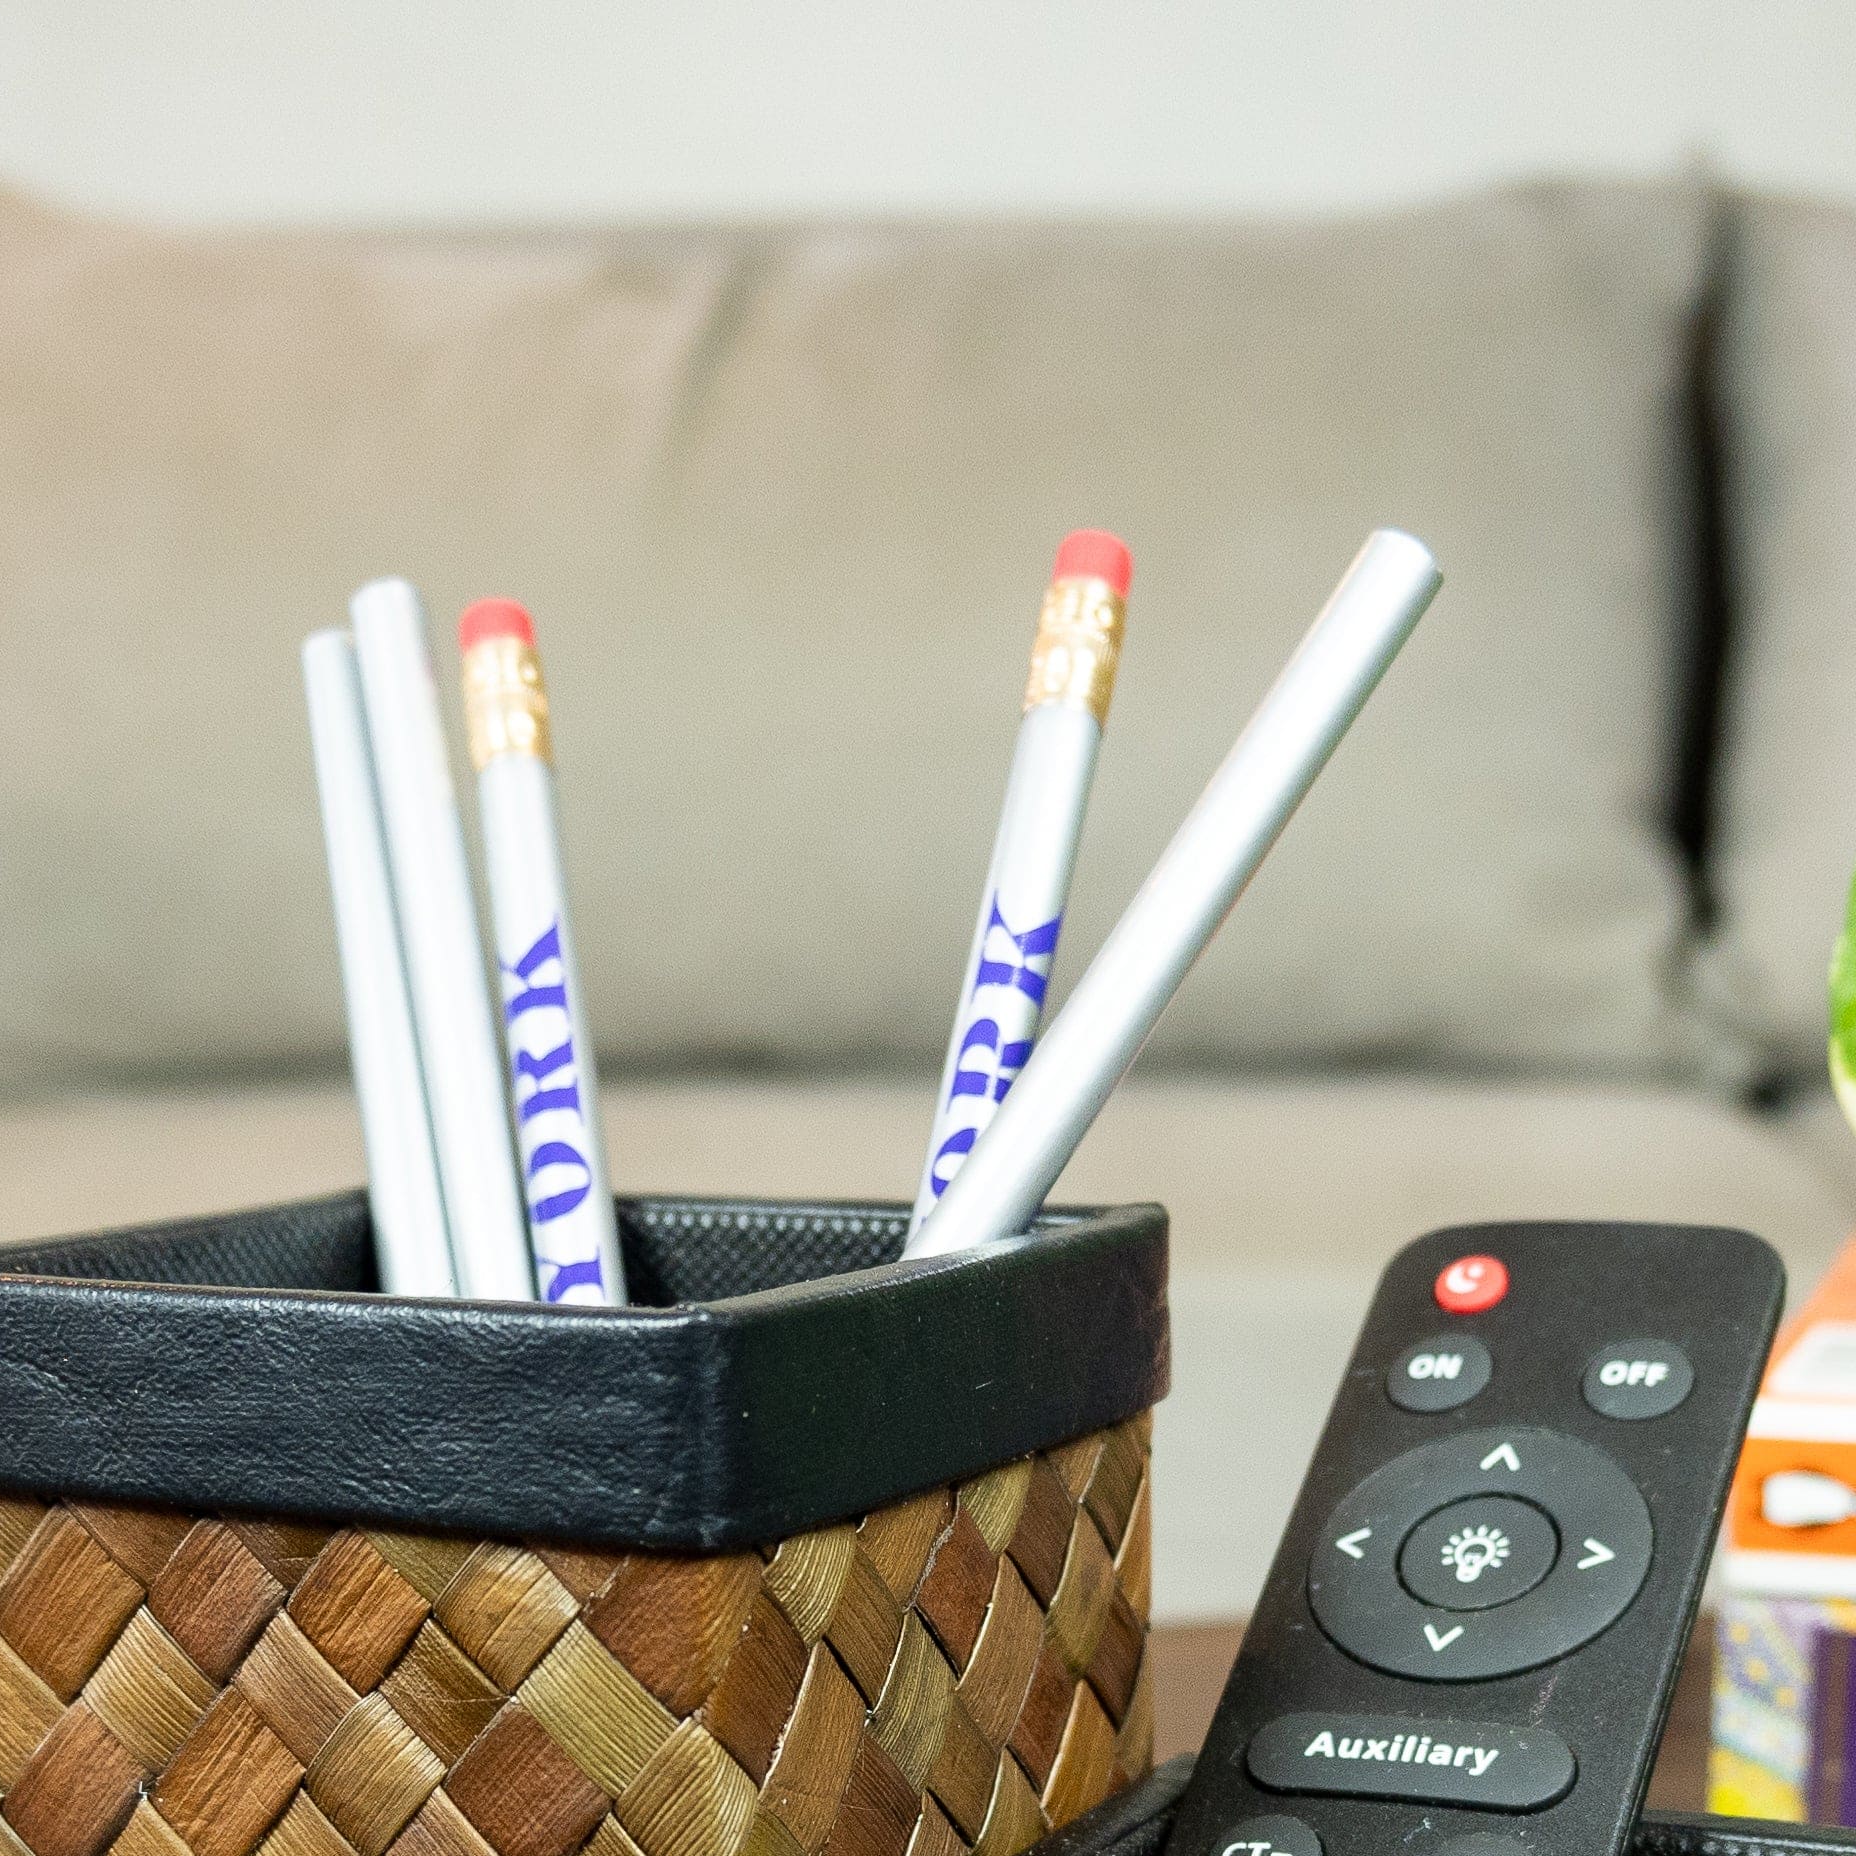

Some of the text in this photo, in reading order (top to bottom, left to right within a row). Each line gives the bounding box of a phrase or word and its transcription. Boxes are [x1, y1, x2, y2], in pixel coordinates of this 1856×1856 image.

[1406, 1352, 1465, 1381] ON
[1598, 1358, 1673, 1388] OFF
[1303, 1730, 1500, 1777] Auxiliary
